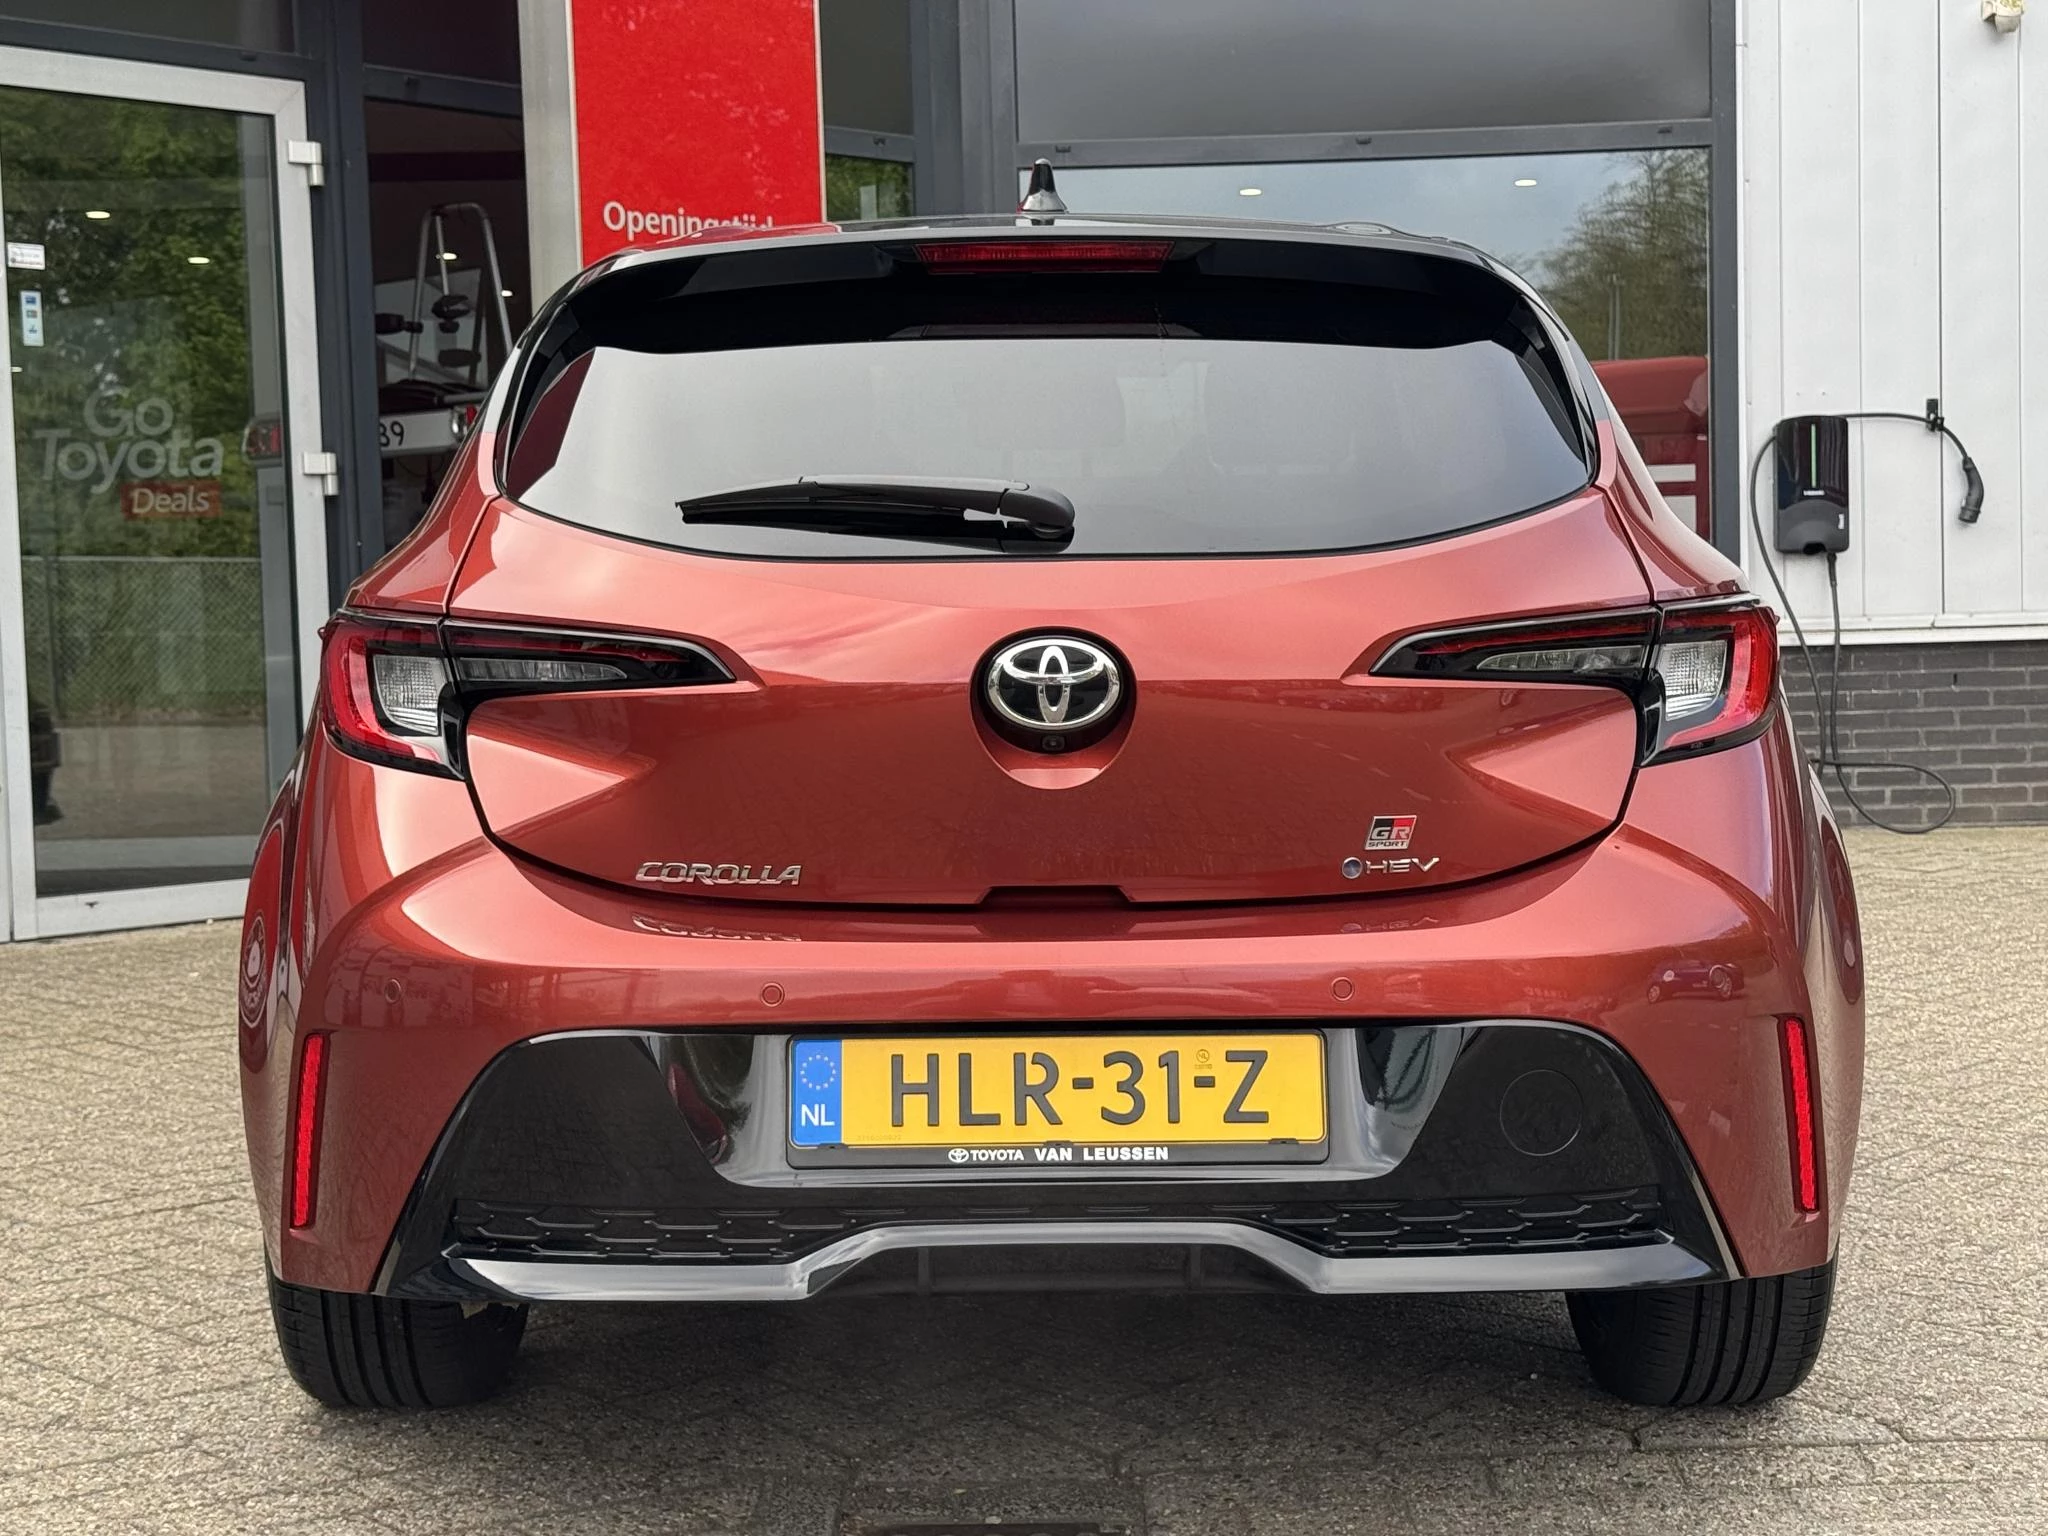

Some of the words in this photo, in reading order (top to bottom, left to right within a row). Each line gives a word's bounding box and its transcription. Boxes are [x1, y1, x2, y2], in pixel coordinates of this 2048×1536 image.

[84, 387, 174, 437] Go
[33, 428, 224, 494] Toyota
[130, 486, 210, 514] Deals
[1371, 826, 1411, 841] GR
[635, 862, 802, 885] COROLLA
[891, 1050, 1270, 1127] HLR-31-Z
[801, 1104, 835, 1127] NL
[970, 1149, 1025, 1161] TOYOTA
[1034, 1147, 1073, 1161] VAN
[1083, 1146, 1169, 1161] LEUSSEN
